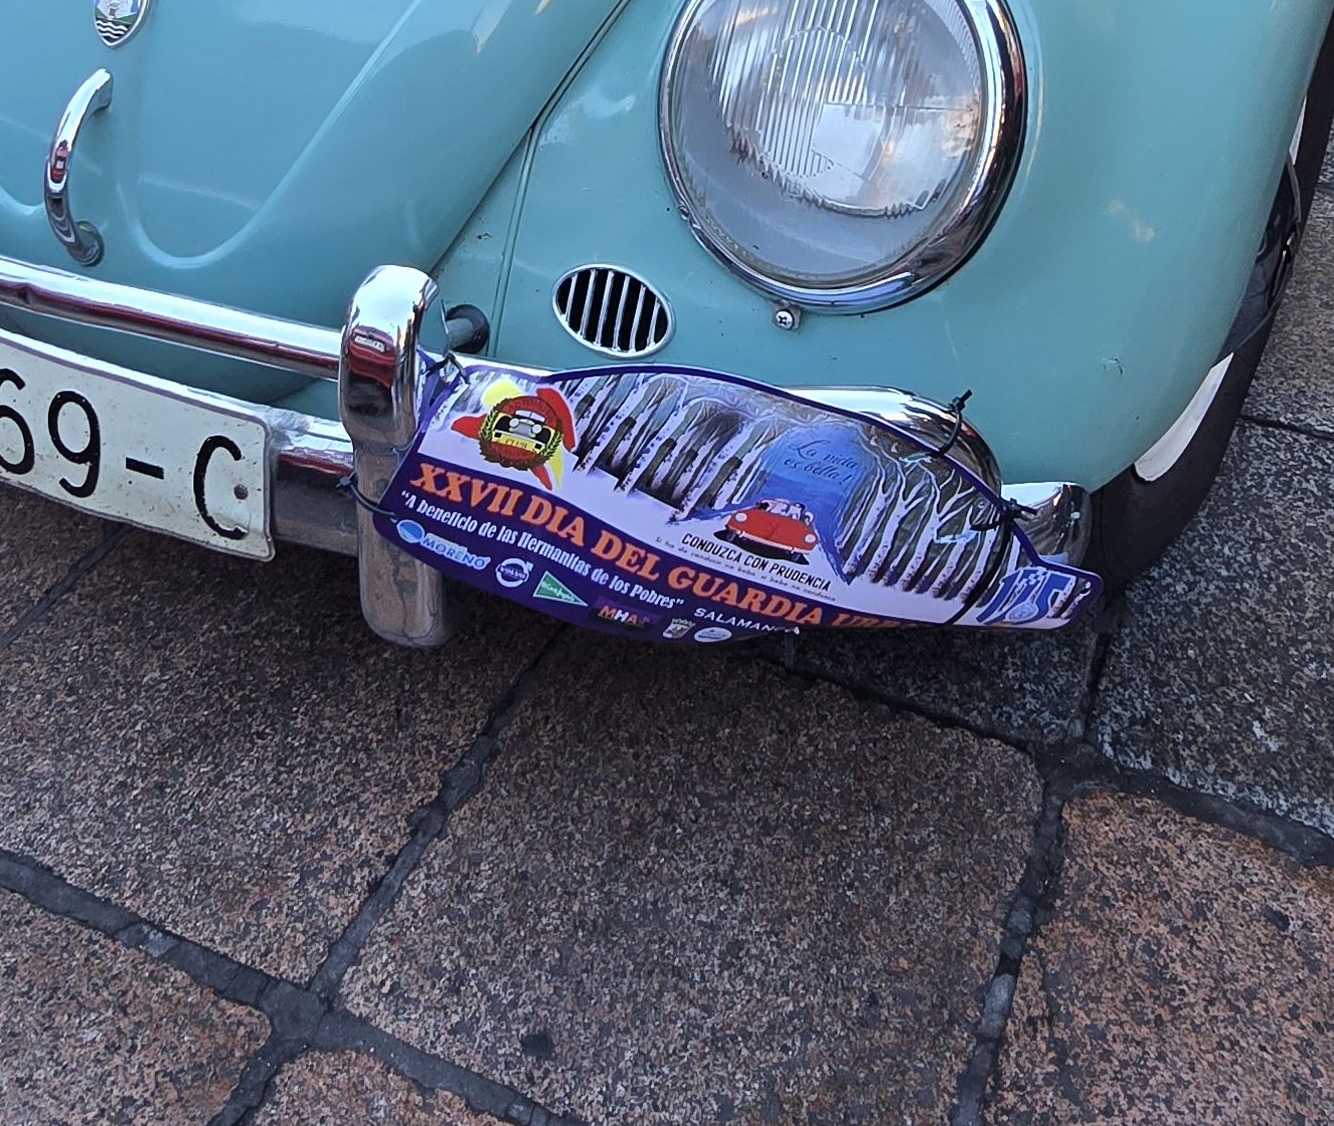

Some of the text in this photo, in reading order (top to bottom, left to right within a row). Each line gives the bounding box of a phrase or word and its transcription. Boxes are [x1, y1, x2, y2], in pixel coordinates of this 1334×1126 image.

[784, 458, 802, 469] es
[787, 439, 859, 470] La vida
[410, 462, 824, 625] XXVII DIA DEL GUARDIA
[416, 500, 478, 534] beneficio
[478, 520, 497, 539] de
[496, 525, 518, 545] las
[516, 531, 593, 577] Hermanitas
[590, 568, 611, 586] de
[608, 575, 630, 595] los
[422, 537, 486, 568] MORENO
[681, 532, 832, 592] CONDUZCA CON PRUDENCIA
[693, 607, 801, 635] SALAMAN
